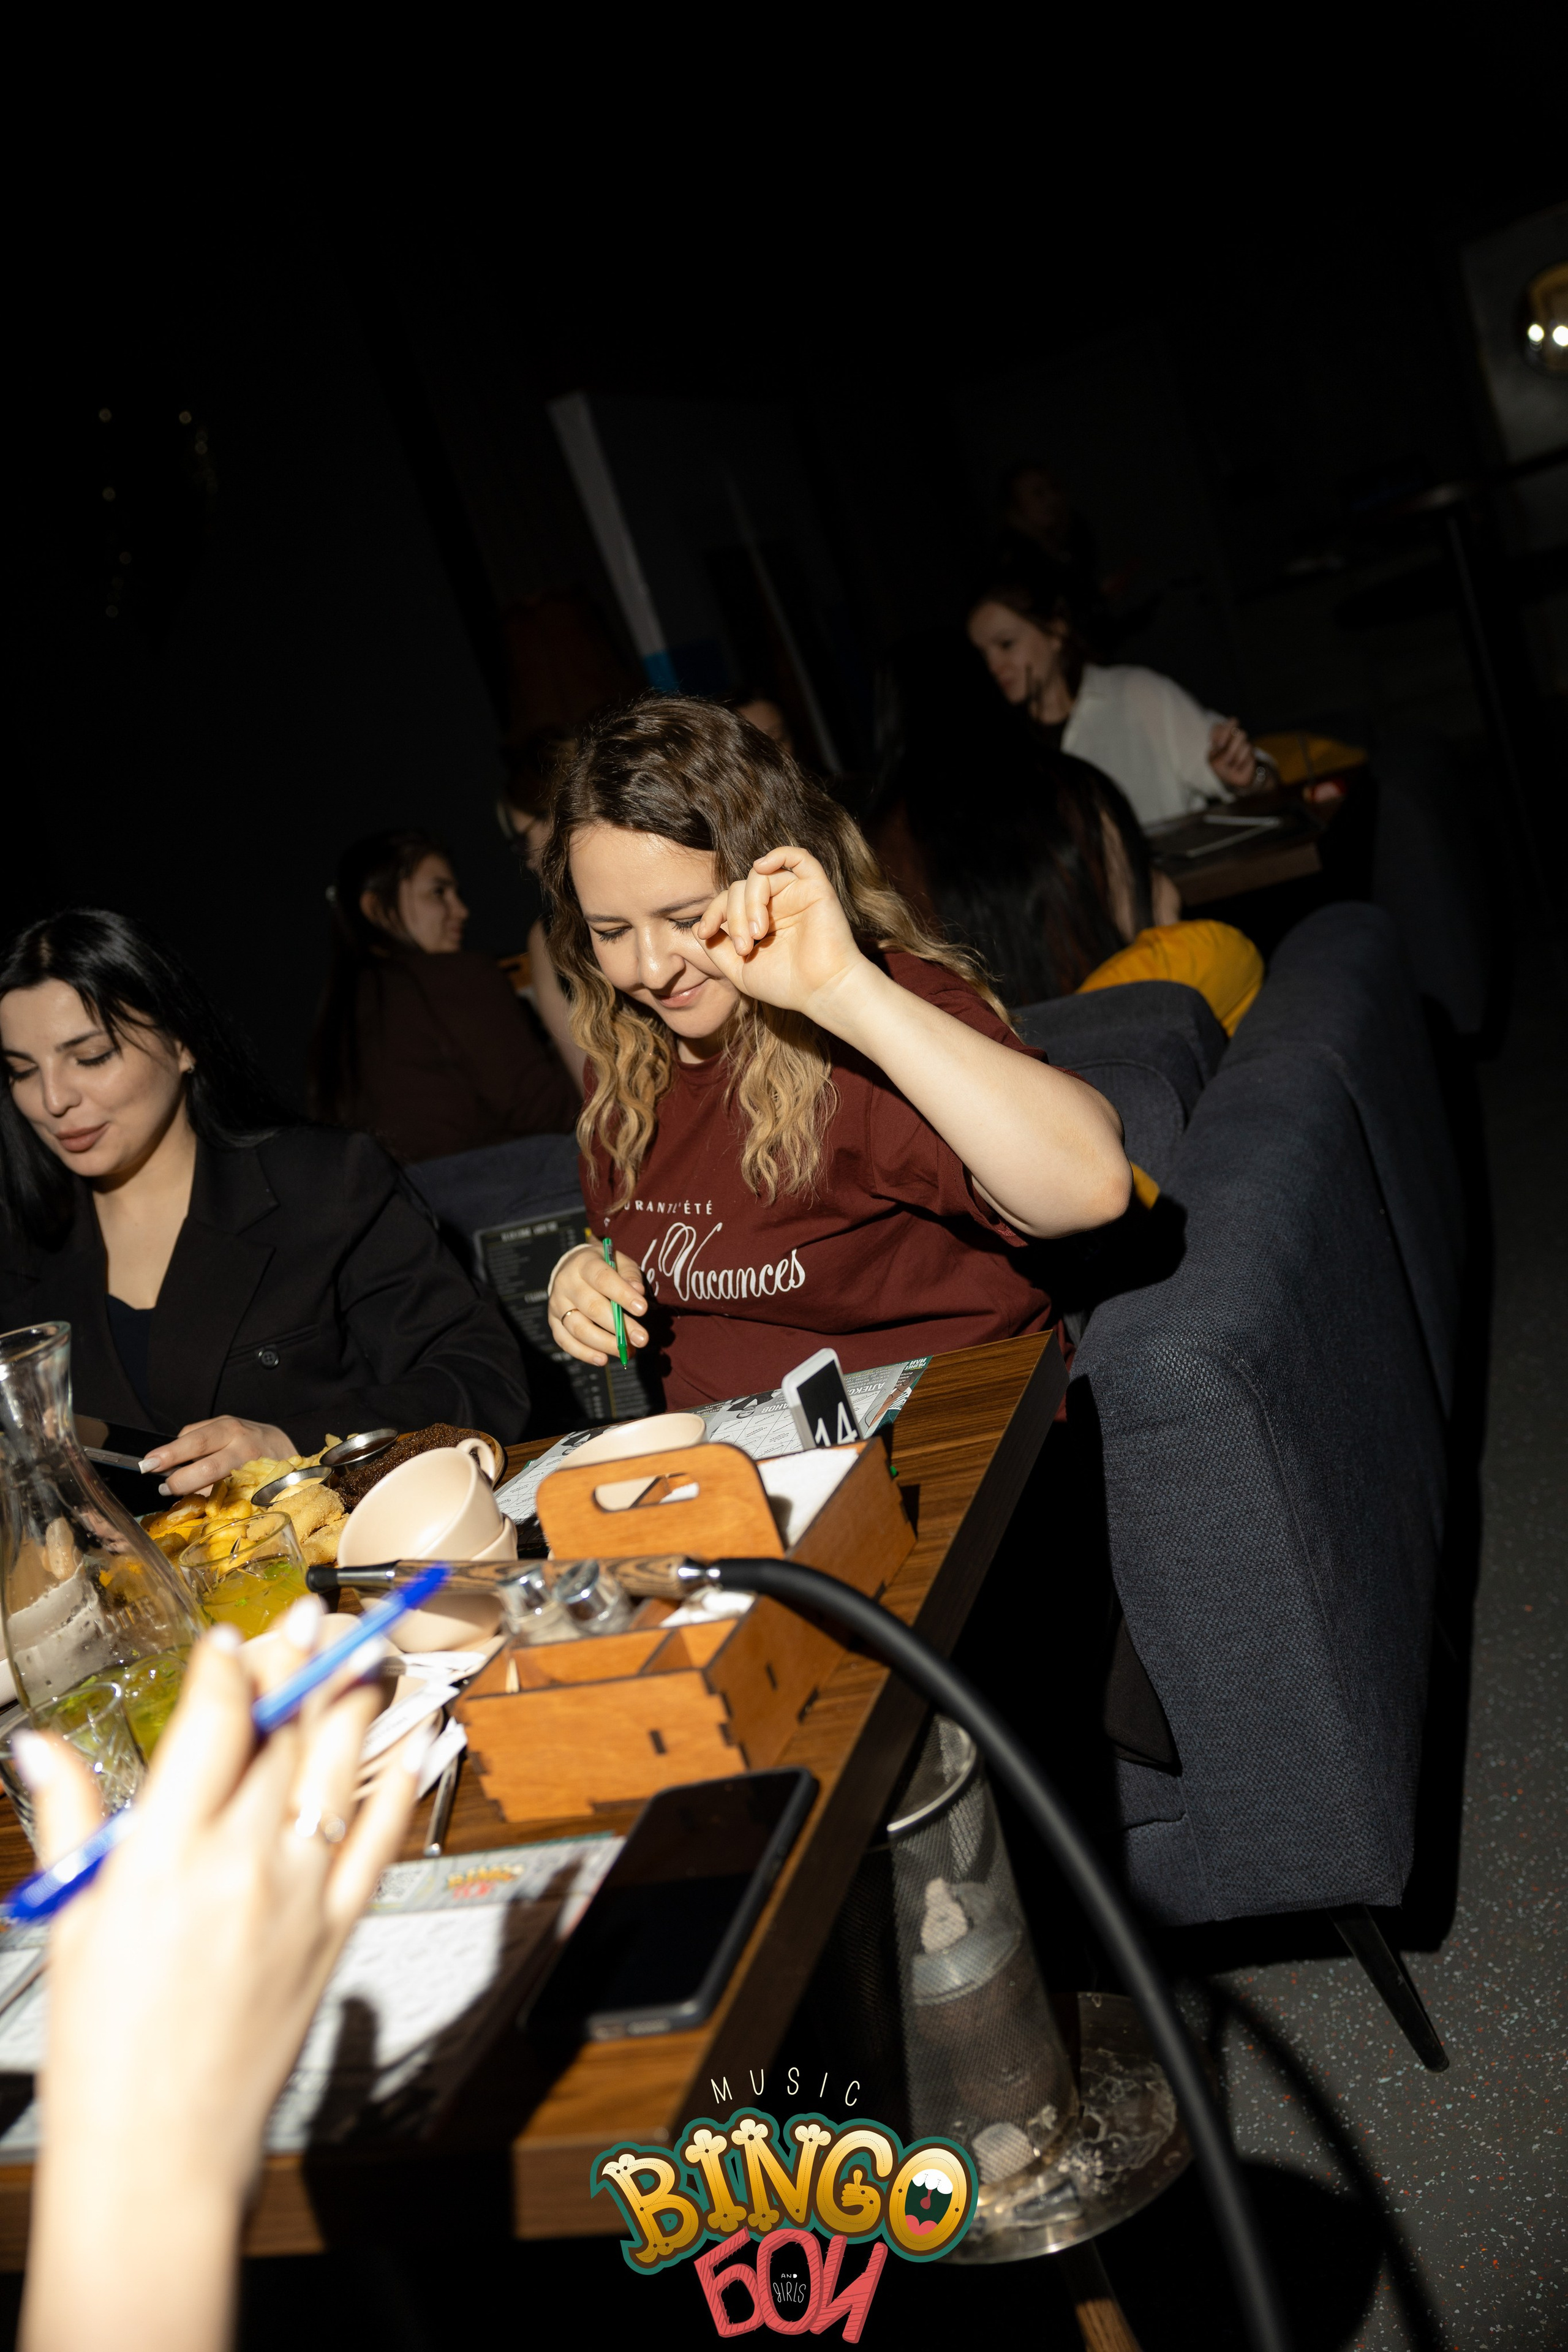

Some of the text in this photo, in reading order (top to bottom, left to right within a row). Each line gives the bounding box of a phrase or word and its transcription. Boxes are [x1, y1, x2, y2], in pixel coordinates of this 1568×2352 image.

[658, 1222, 805, 1302] Vacances
[846, 1382, 886, 1395] АЛЕКС
[815, 1401, 858, 1447] 14
